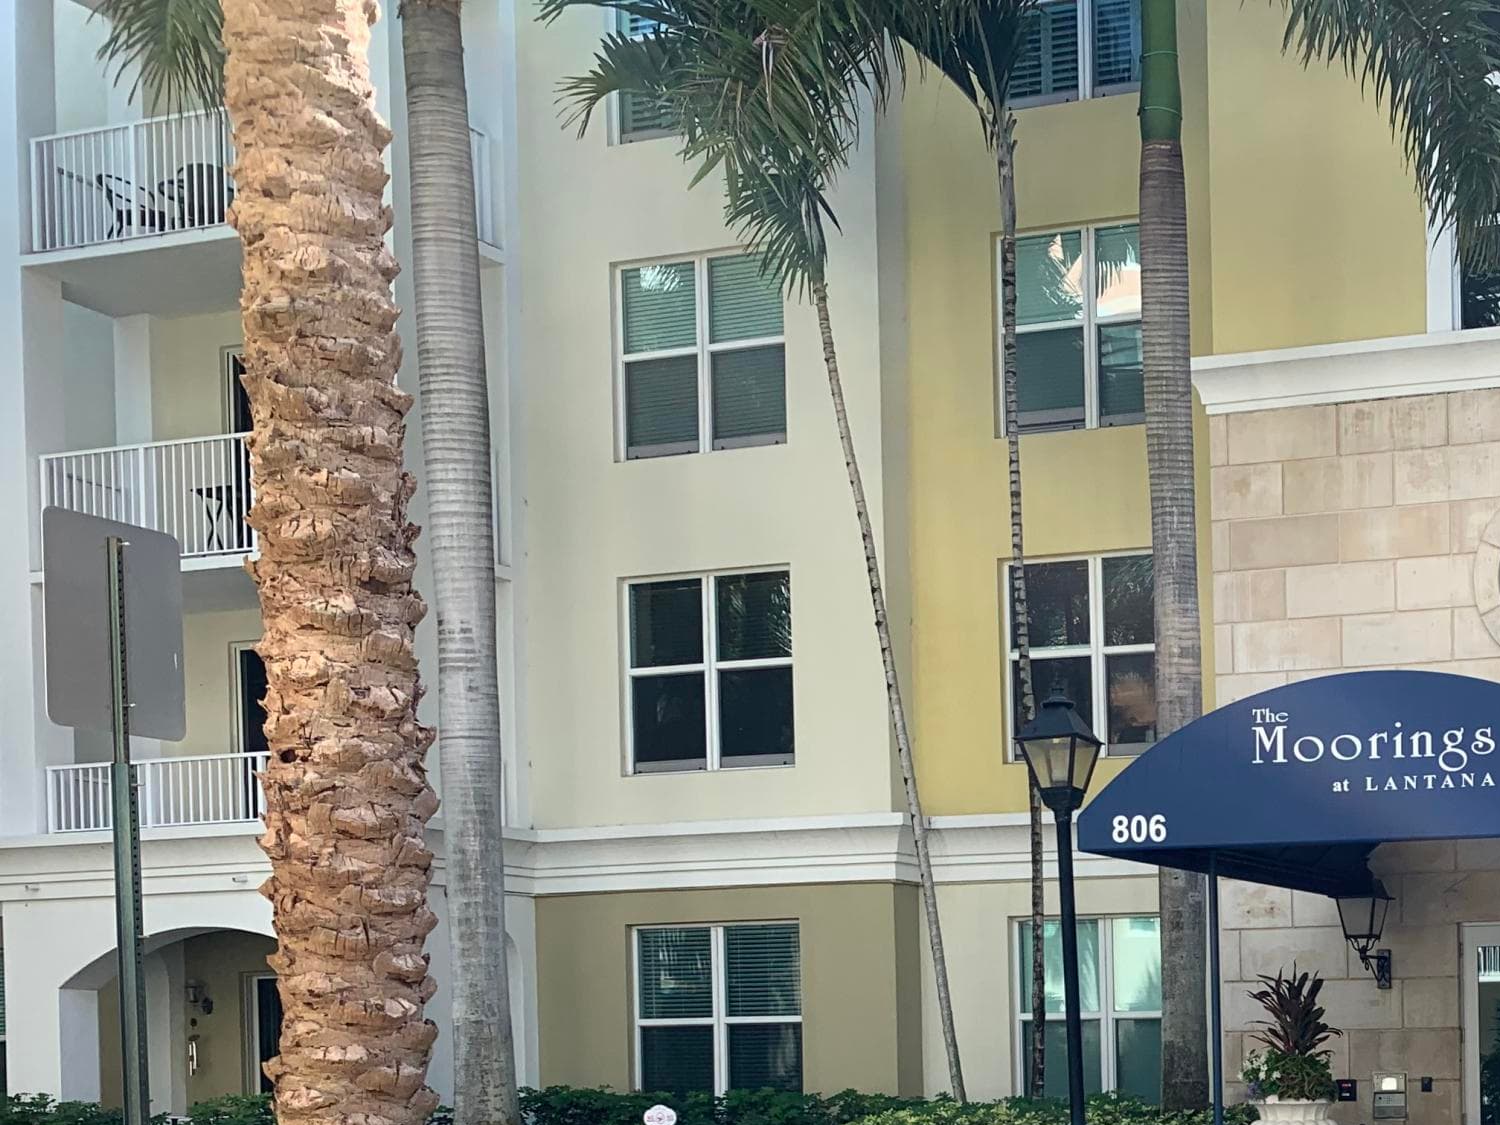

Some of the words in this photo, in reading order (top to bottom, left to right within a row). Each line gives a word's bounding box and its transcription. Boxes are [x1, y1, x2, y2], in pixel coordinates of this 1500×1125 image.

[1252, 708, 1289, 723] The
[1251, 721, 1496, 772] Moorings
[1333, 778, 1350, 792] at
[1365, 772, 1496, 791] LANTANA
[1112, 814, 1167, 843] 806
